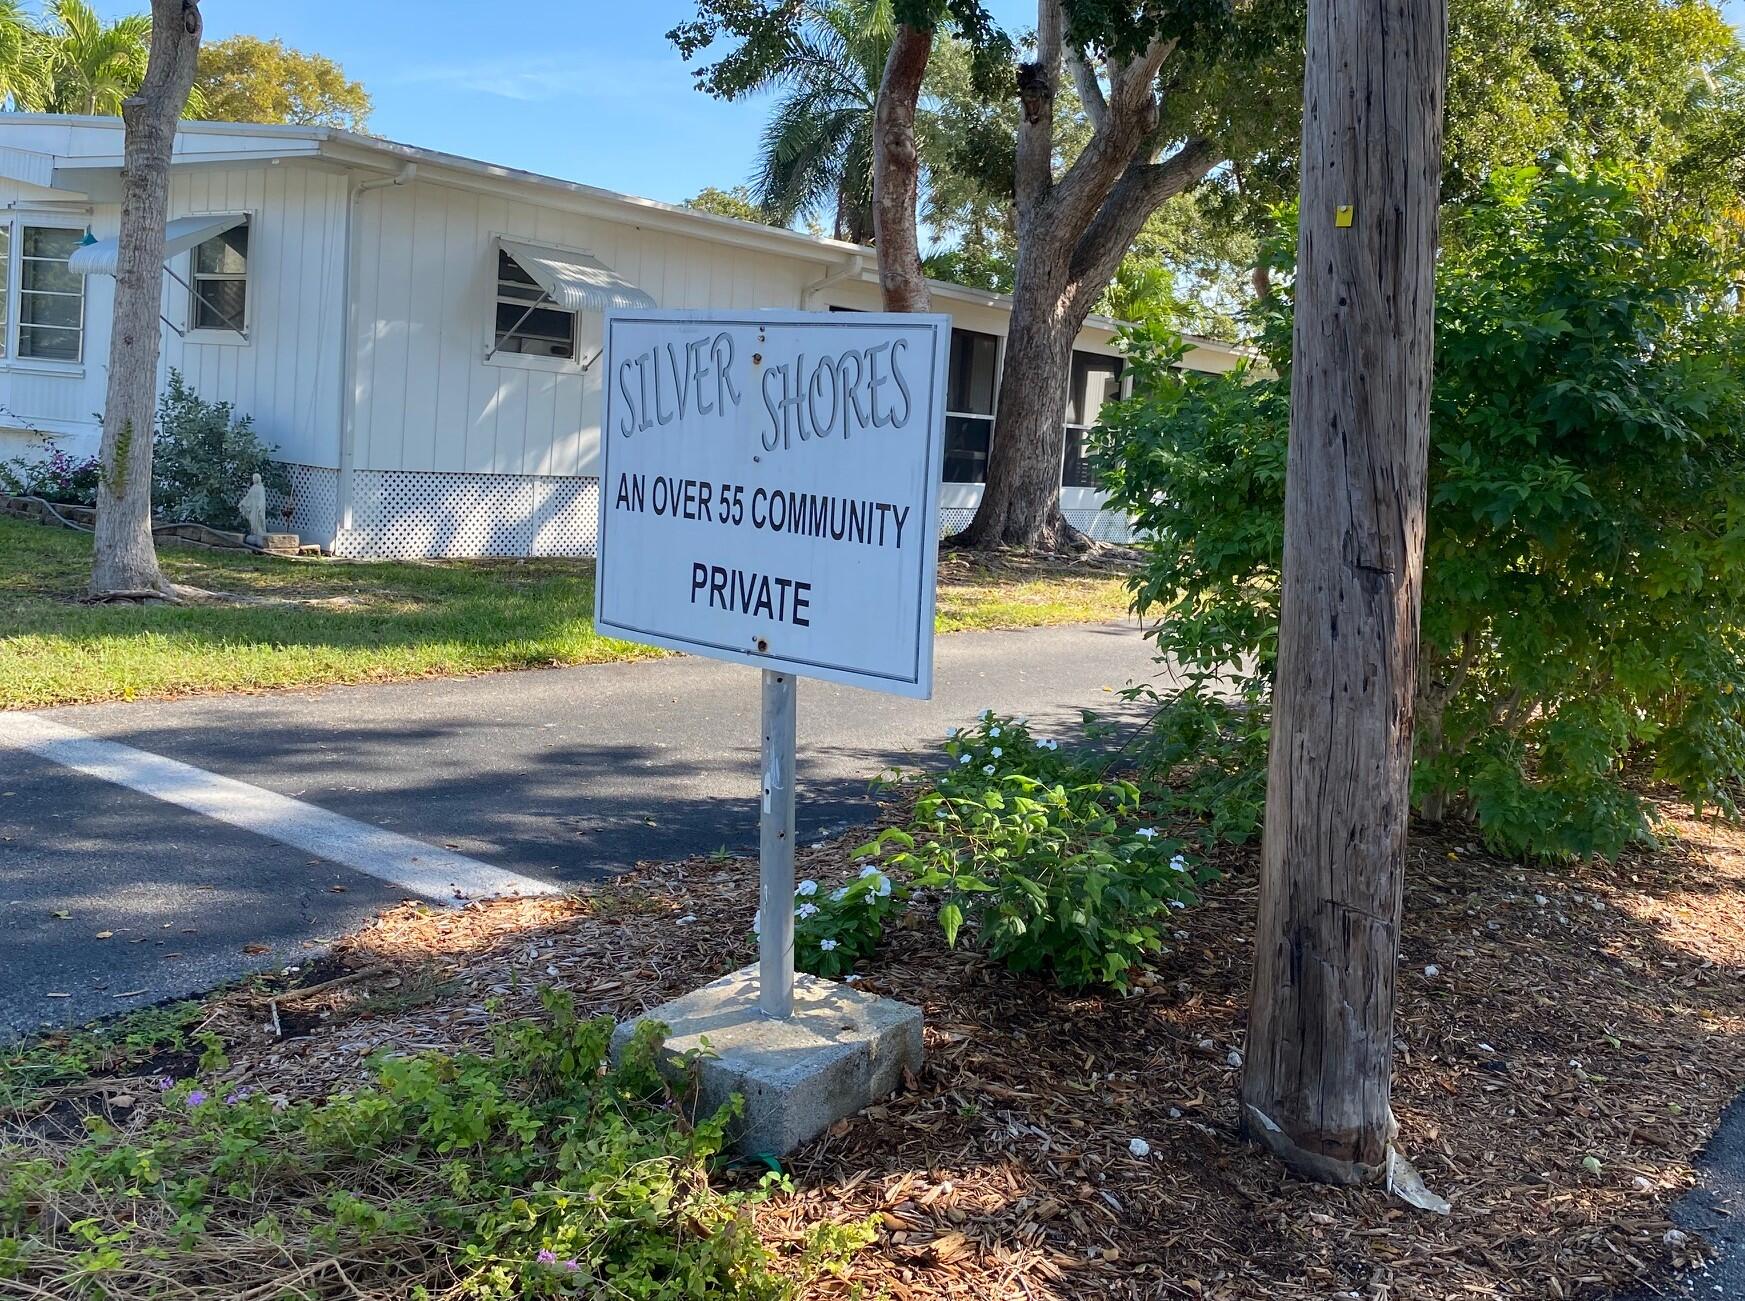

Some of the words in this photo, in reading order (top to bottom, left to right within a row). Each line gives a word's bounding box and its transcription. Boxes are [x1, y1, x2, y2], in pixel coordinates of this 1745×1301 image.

[619, 331, 742, 438] SILVER
[761, 338, 912, 452] SHORES
[615, 473, 645, 513] AN
[652, 476, 712, 523] OVER
[719, 483, 744, 527] 55
[752, 487, 910, 549] COMMUNITY
[690, 562, 812, 627] PRIVATE
